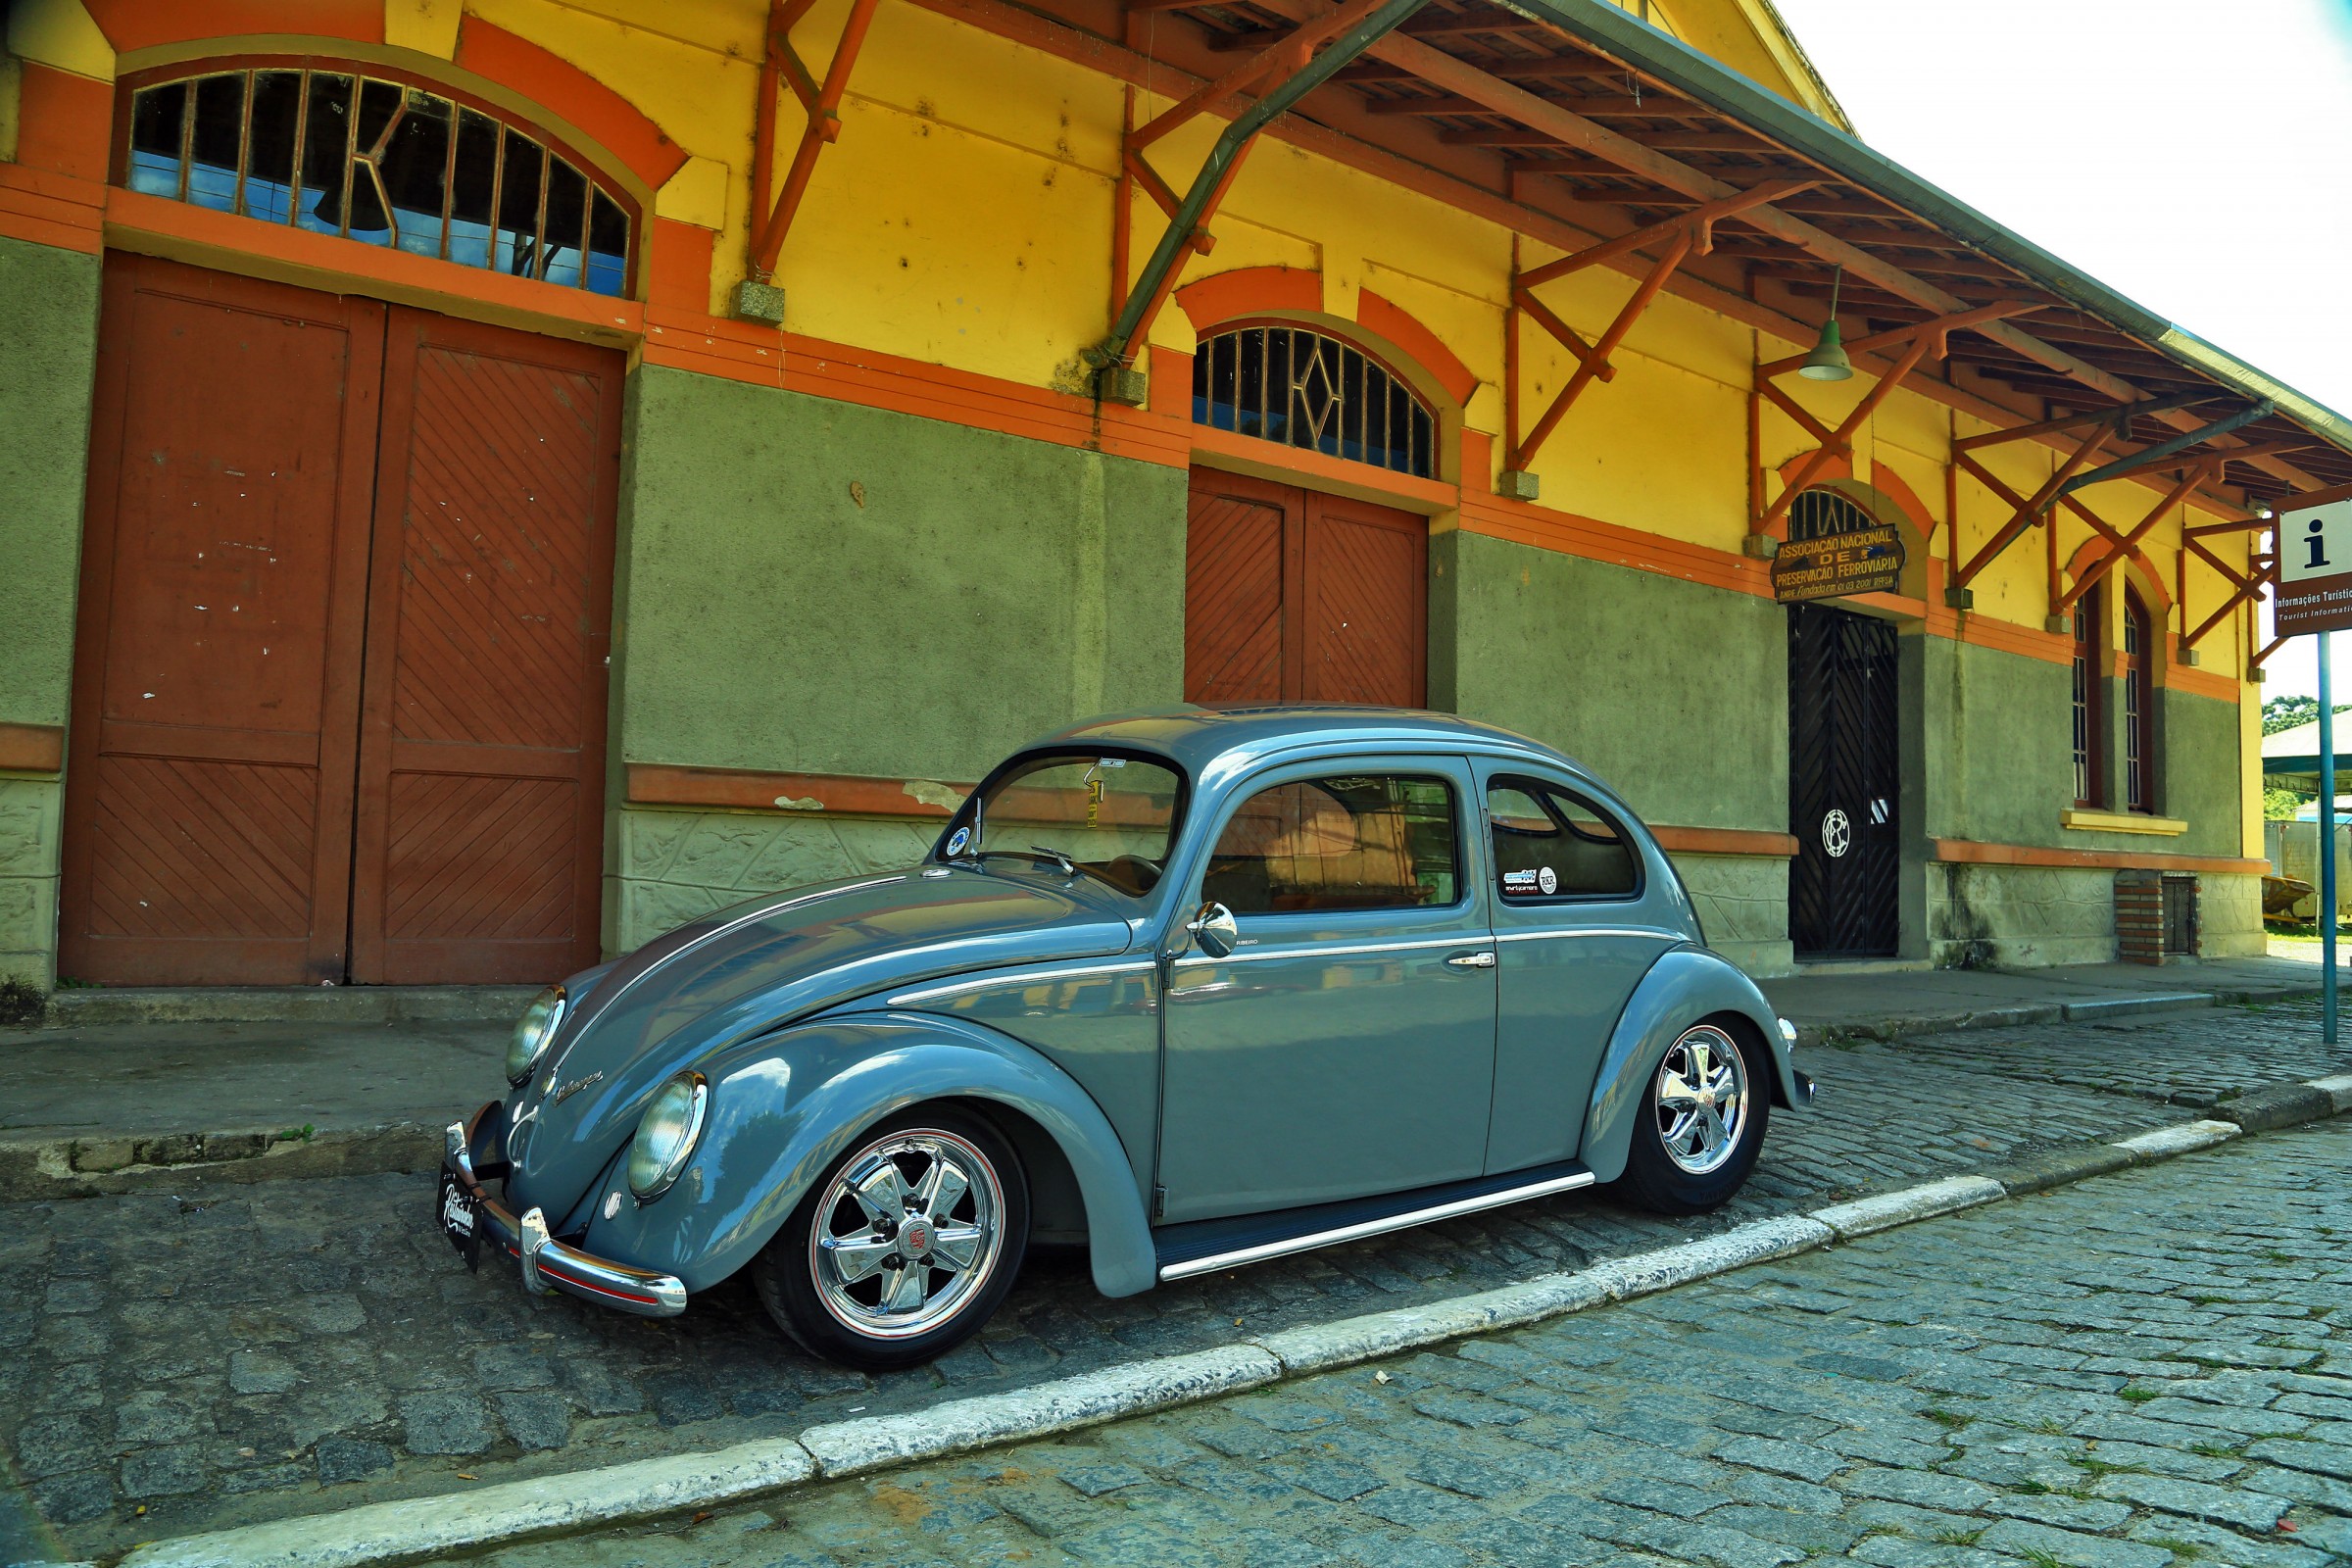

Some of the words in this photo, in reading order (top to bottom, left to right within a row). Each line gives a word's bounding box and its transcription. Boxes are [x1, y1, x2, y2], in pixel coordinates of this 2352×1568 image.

[1840, 530, 1892, 549] NACIONAL
[1820, 551, 1850, 565] DE
[1838, 556, 1898, 578] FERROVIÁRIA
[2275, 594, 2321, 608] Informações
[2278, 612, 2308, 620] Tourist
